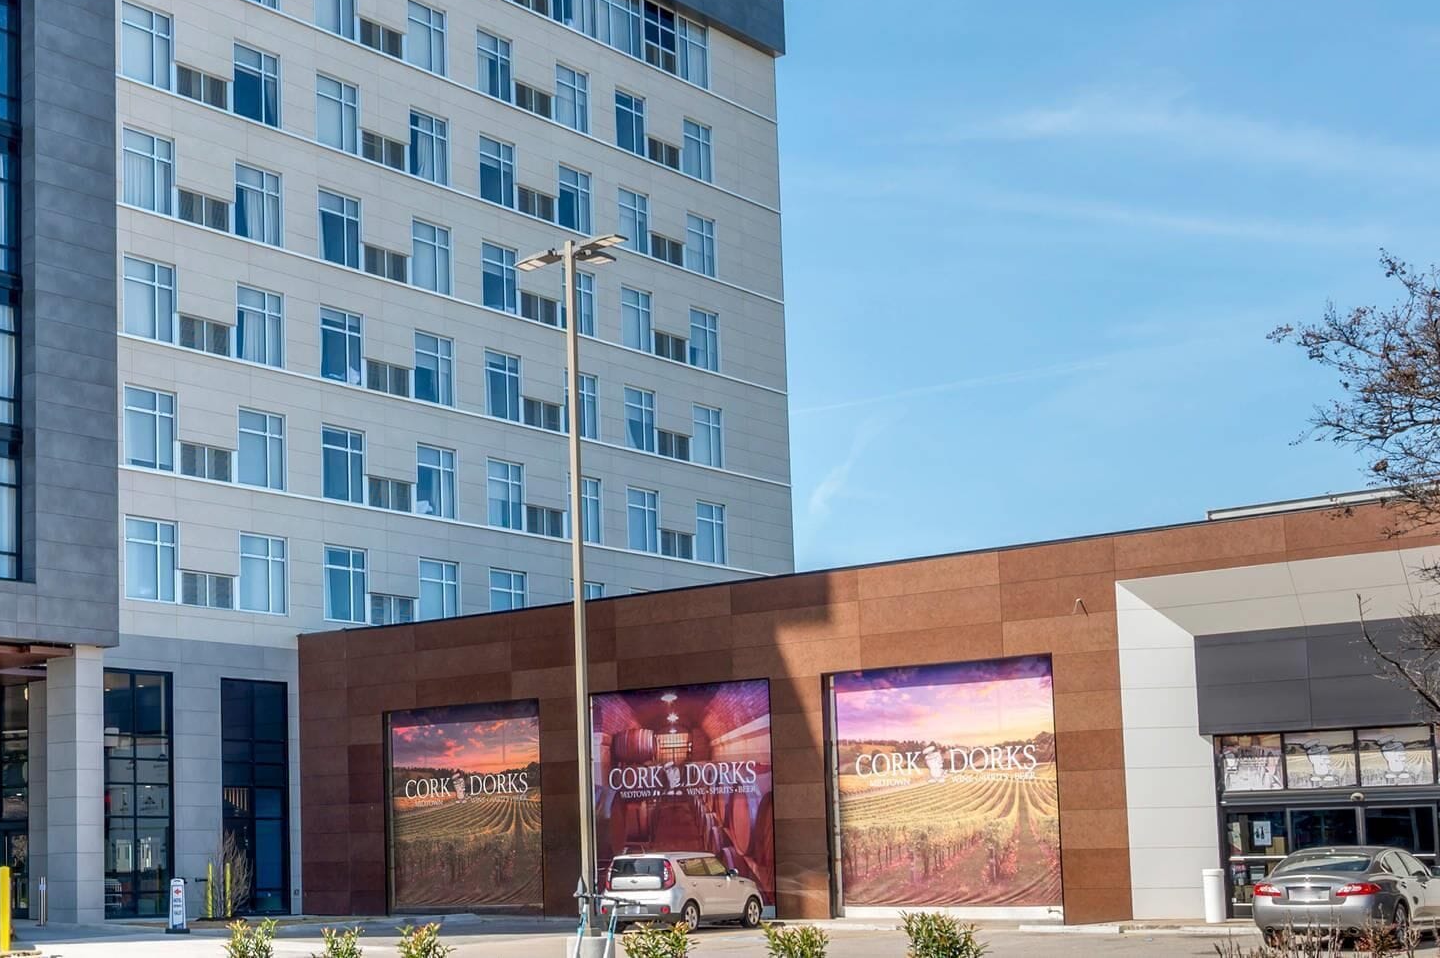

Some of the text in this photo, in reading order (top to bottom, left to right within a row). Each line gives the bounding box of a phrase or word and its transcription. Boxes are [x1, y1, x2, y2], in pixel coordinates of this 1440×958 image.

[609, 760, 757, 790] CORK DORKS
[855, 744, 1037, 778] CORK DORKS
[405, 772, 528, 799] CORK DORKS
[686, 787, 706, 795] WINE
